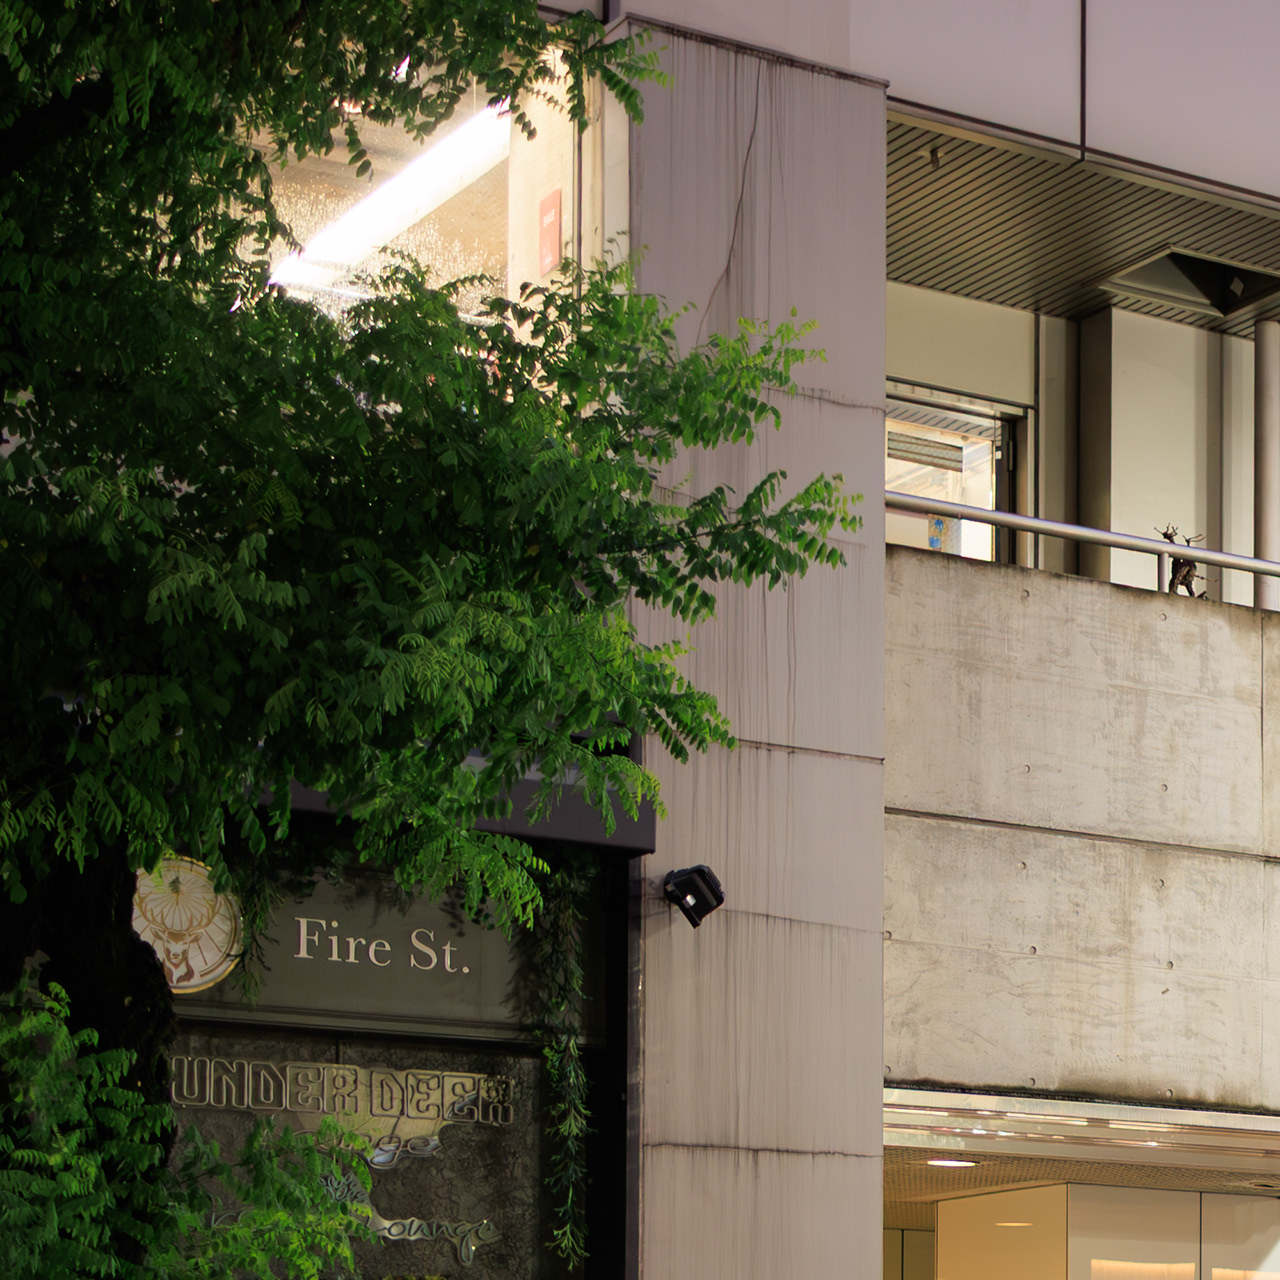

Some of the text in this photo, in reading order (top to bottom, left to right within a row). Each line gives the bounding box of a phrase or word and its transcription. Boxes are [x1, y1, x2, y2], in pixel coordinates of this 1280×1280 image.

[294, 917, 470, 974] Fire St.
[172, 1056, 514, 1126] UNDER DEER
